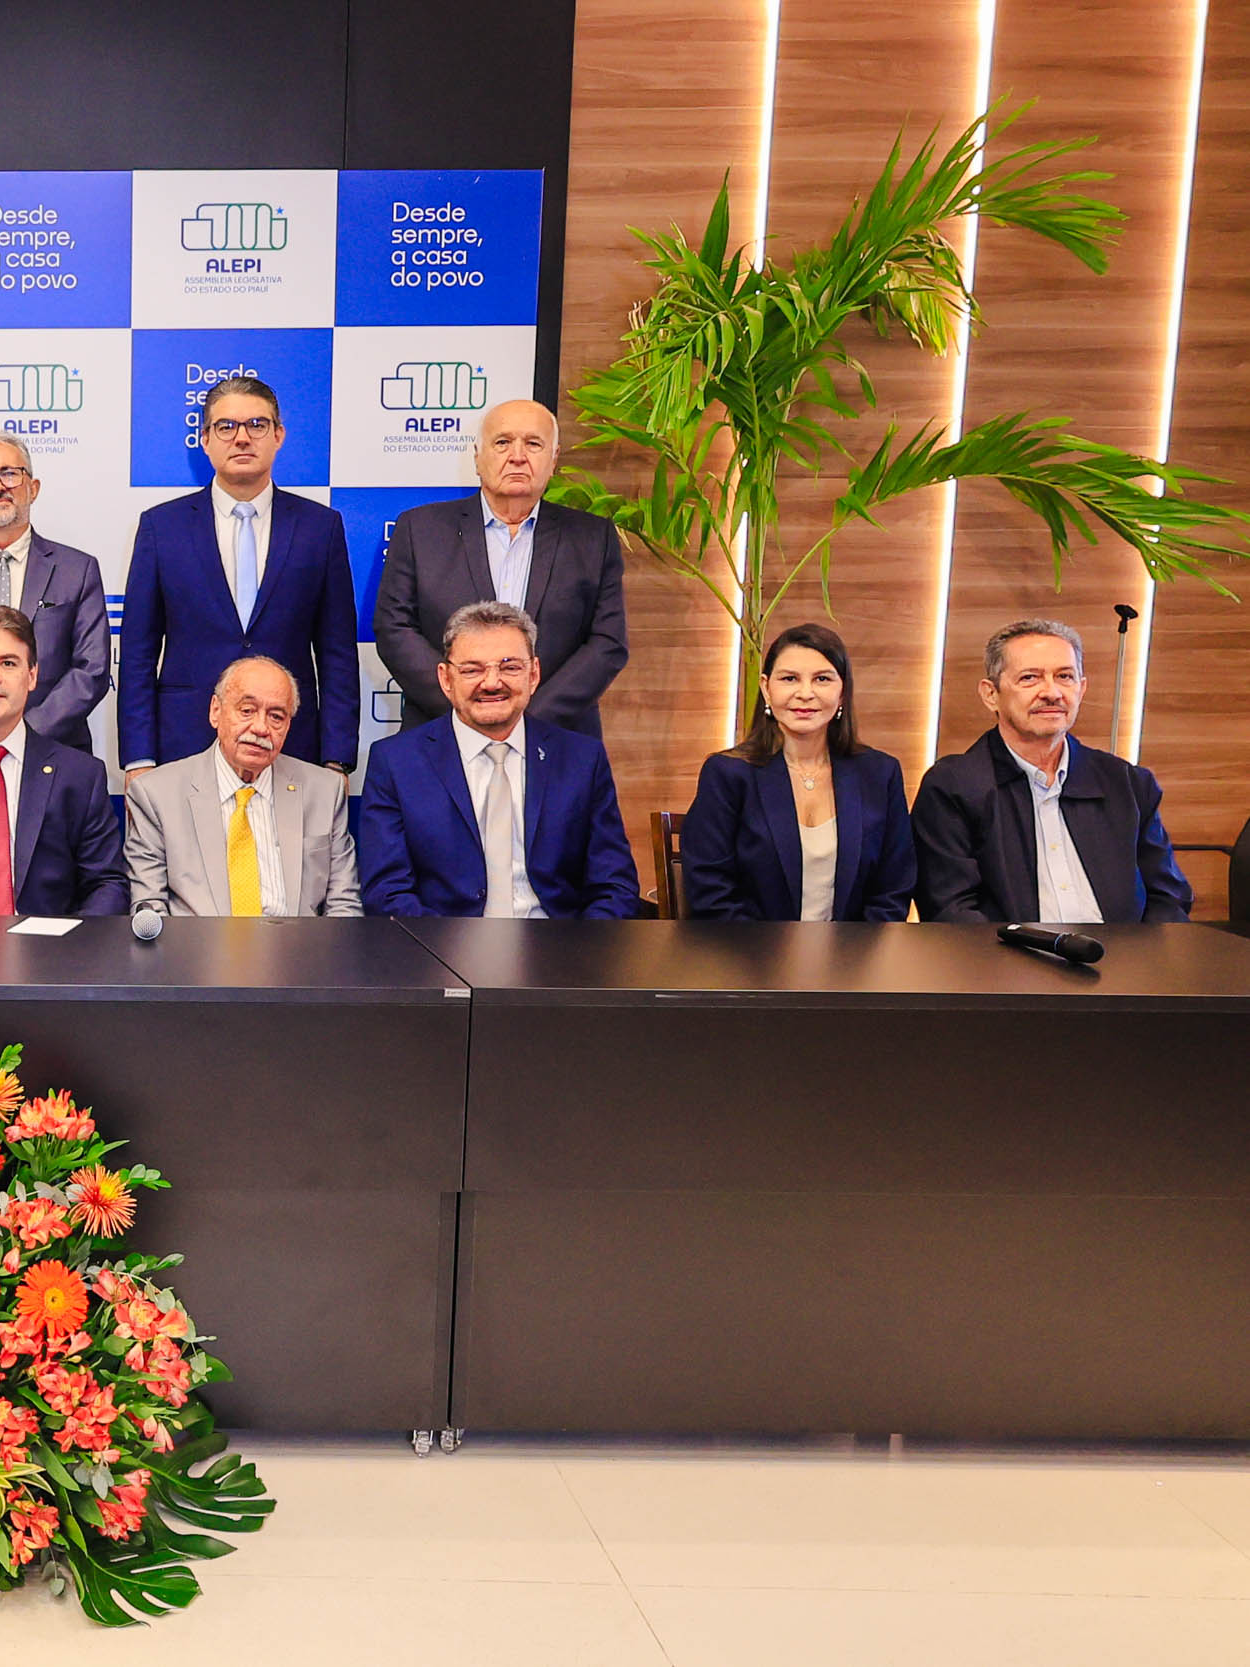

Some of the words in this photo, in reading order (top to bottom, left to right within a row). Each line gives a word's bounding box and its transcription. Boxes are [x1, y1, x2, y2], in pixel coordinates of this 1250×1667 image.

[392, 201, 466, 223] Desde
[391, 228, 483, 248] sempre,
[6, 252, 60, 268] casa
[391, 250, 406, 265] a
[412, 250, 467, 265] casa
[206, 258, 261, 273] ALEPI
[21, 274, 78, 294] povo
[184, 276, 232, 284] ASSEMBLEIA
[234, 276, 282, 284] LEGISLATIVA
[391, 266, 421, 287] do
[427, 271, 484, 291] povo
[184, 286, 198, 294] DO
[199, 286, 231, 294] ESTADO
[233, 286, 246, 294] DO
[4, 419, 58, 434] ALEPI
[185, 412, 200, 427] a
[405, 418, 461, 432] ALEPI
[31, 437, 79, 445] LEGISLATIVA
[433, 435, 476, 443] LEGISLATIV
[383, 445, 397, 453] DO
[398, 445, 430, 453] ESTADO
[432, 445, 445, 453] DO
